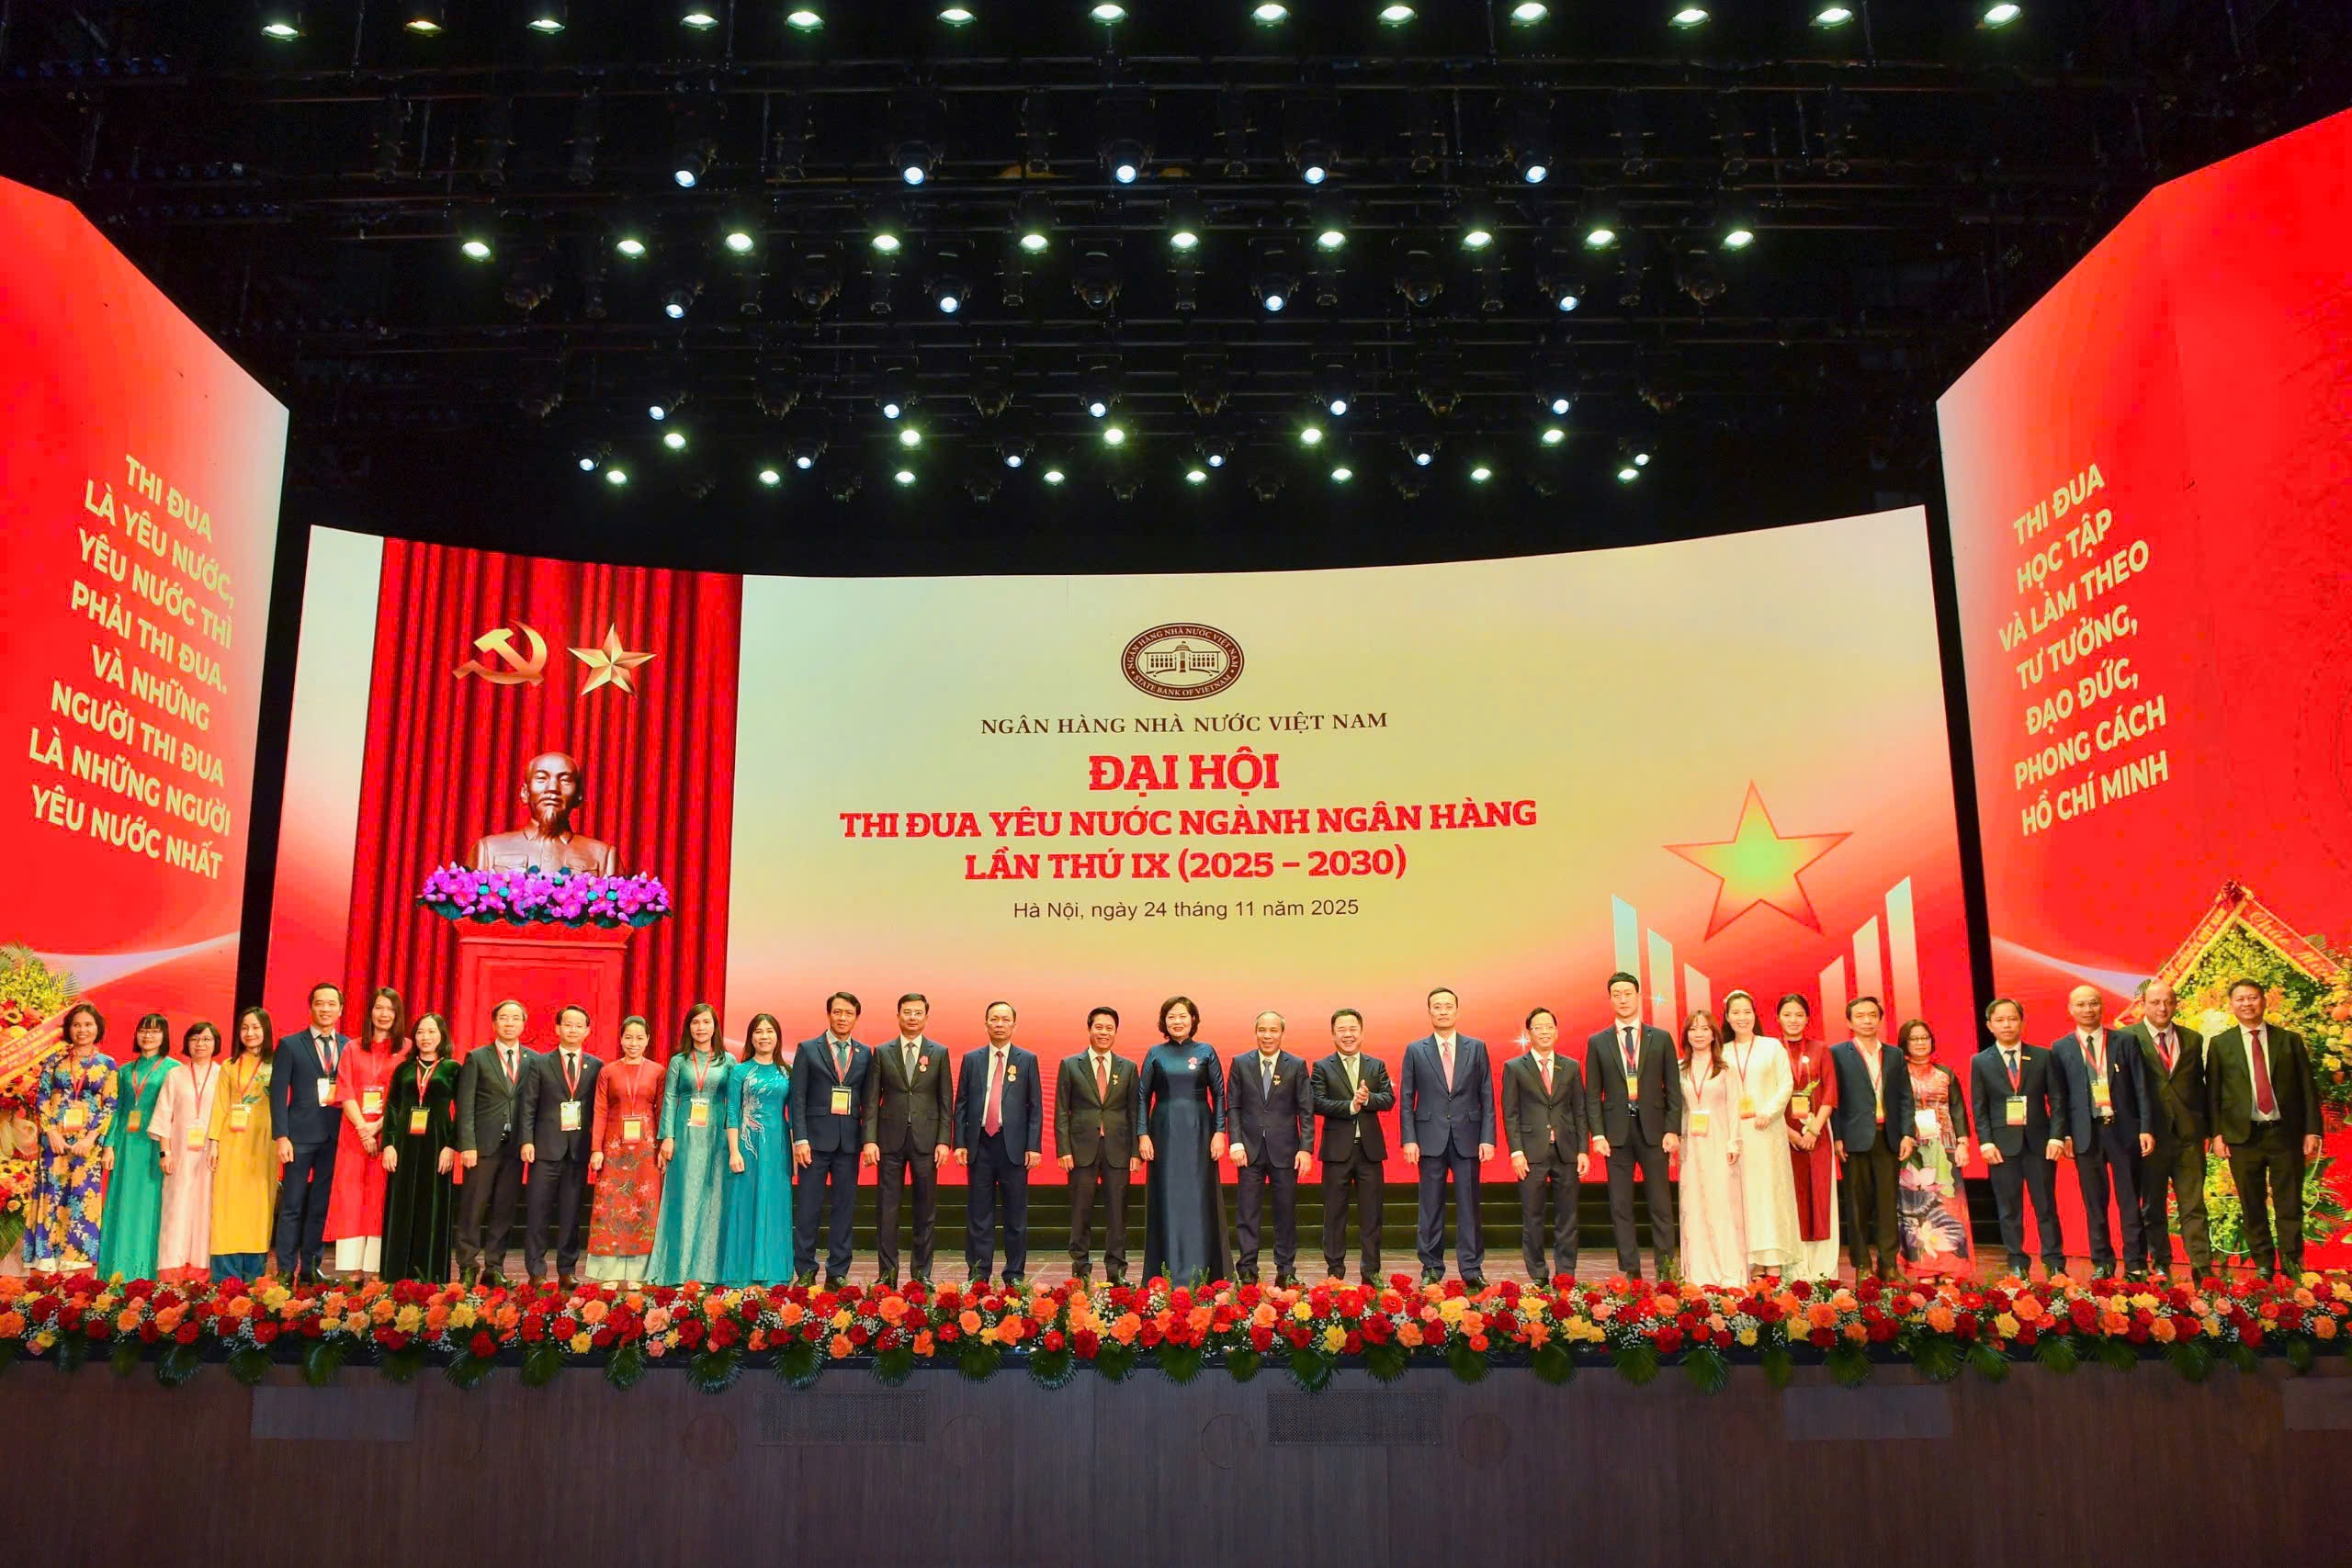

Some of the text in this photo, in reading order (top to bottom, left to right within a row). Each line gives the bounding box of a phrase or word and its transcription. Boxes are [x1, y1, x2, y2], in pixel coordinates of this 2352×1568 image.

[126, 454, 211, 541] THI ĐUA
[2014, 463, 2106, 545] THI ĐUA
[85, 479, 234, 607] LÀ YÊU NƯỚC,
[2018, 508, 2113, 593] HỌC TẬP
[78, 527, 232, 649] YÊU NƯỚC THÌ
[1999, 540, 2150, 651] VÀ LÀM THEO
[71, 580, 227, 694] PHẢI THI ĐUA.
[2017, 604, 2138, 690] TƯ TƯỞNG,
[92, 644, 209, 730] VÀ NHỮNG
[981, 711, 1387, 734] NGÂN HÀNG NHÀ NƯỚC VIỆT NAM
[1134, 675, 1156, 692] STATE
[1158, 687, 1181, 695] BANK
[1195, 675, 1232, 694] VIETNAM
[2026, 658, 2139, 735] ĐẠO ĐỨC,
[51, 681, 224, 786] NGƯỜI THI ĐUA
[1089, 746, 1279, 797] ĐẠI HỘI
[2014, 694, 2167, 790] PHONG CÁCH
[28, 727, 231, 836] LÀ NHỮNG NGƯỜI
[840, 798, 1536, 838] THI ĐUA YÊU NƯỚC NGÀNH NGÂN HÀNG
[2021, 750, 2168, 836] HỒ CHÍ MINH
[30, 779, 223, 879] YÊU NƯỚC NHẤT
[965, 846, 1040, 880] LẦN
[1047, 848, 1125, 879] THỨ
[1132, 853, 1170, 878] IX
[1178, 848, 1274, 883] (2025
[1308, 844, 1407, 879] 2030)
[1014, 899, 1358, 920] Hà Nội, ngày 24 tháng 11 năm 2025
